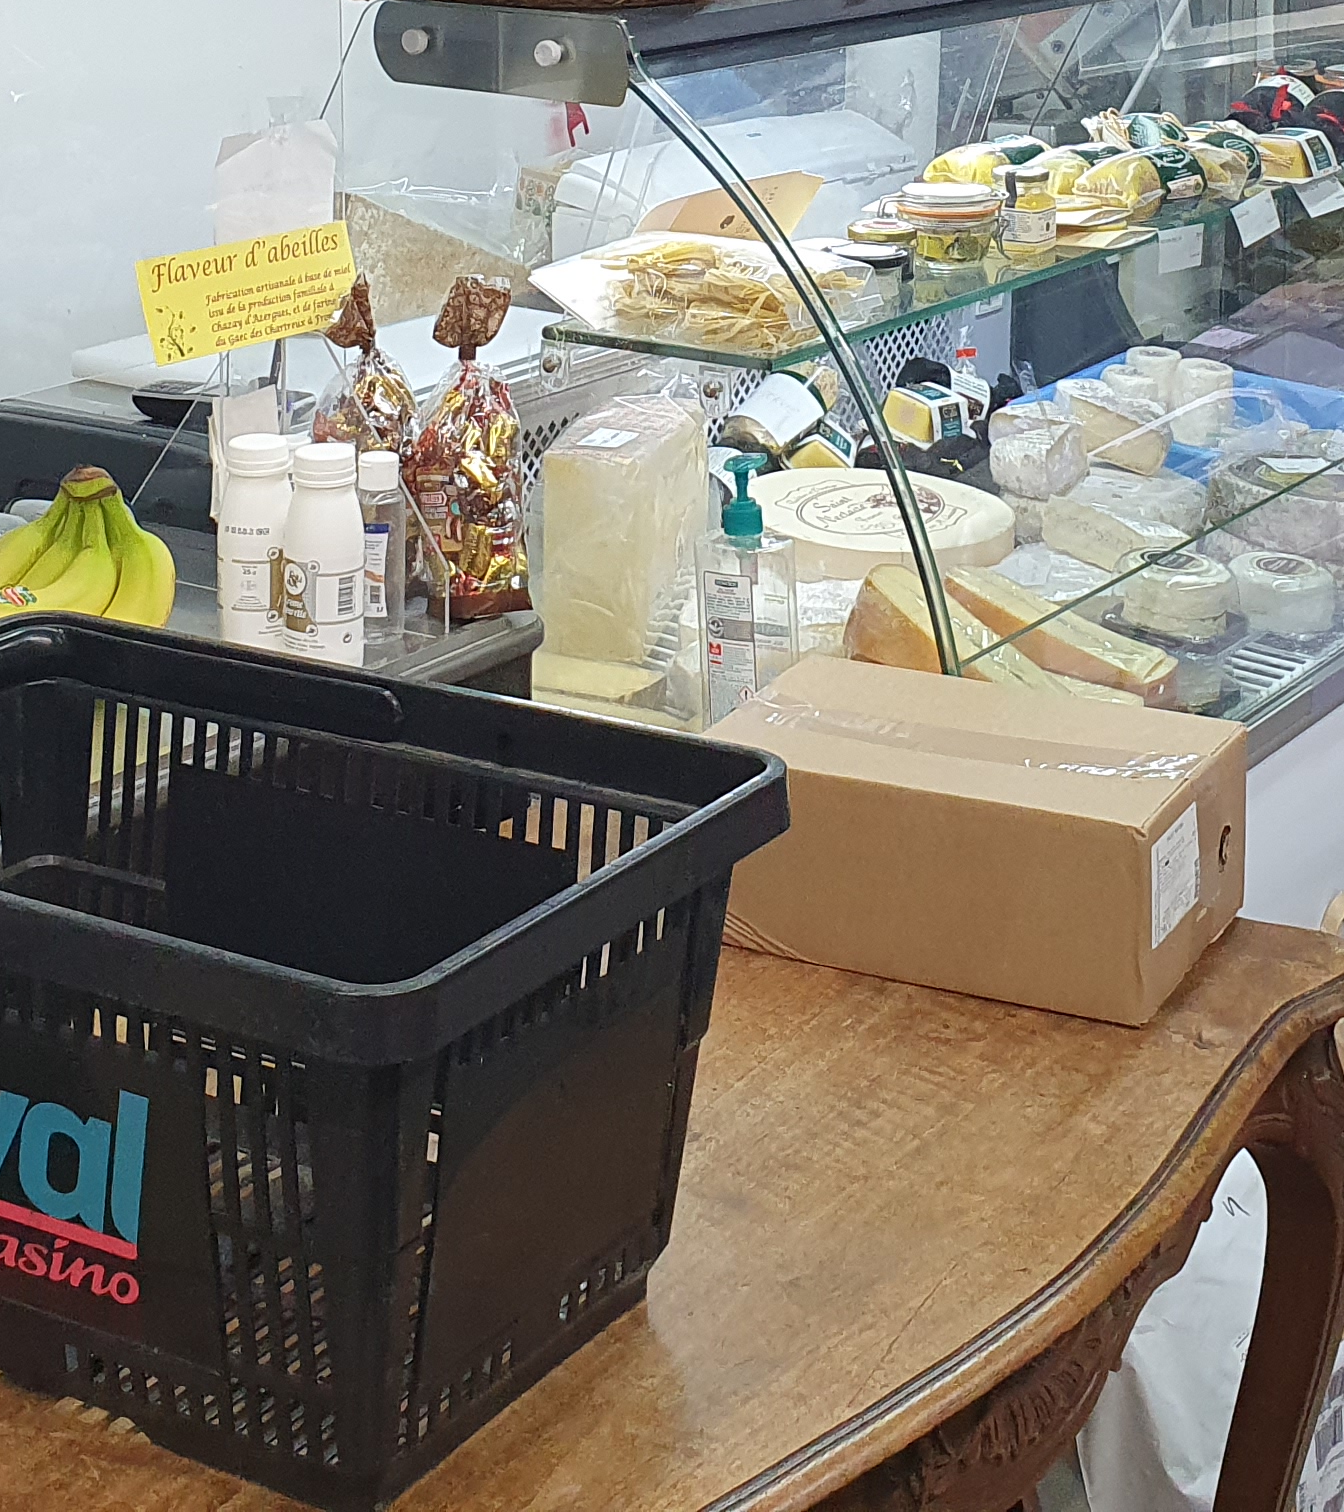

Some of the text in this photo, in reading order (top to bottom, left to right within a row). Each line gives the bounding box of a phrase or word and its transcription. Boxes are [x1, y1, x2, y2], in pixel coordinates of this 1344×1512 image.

[151, 251, 238, 293] Flaveur
[205, 286, 254, 307] Fabrication
[255, 275, 297, 292] artisanale
[304, 271, 322, 283] base
[323, 268, 332, 278] de
[333, 262, 352, 277] miel
[208, 307, 224, 319] issu
[226, 302, 236, 315] de
[238, 300, 246, 312] la
[247, 293, 292, 314] production
[211, 318, 243, 334] Chazay
[293, 305, 301, 315] et
[302, 300, 311, 312] de
[215, 335, 226, 347] du
[250, 327, 263, 339] des
[264, 319, 306, 336] Chartreux
